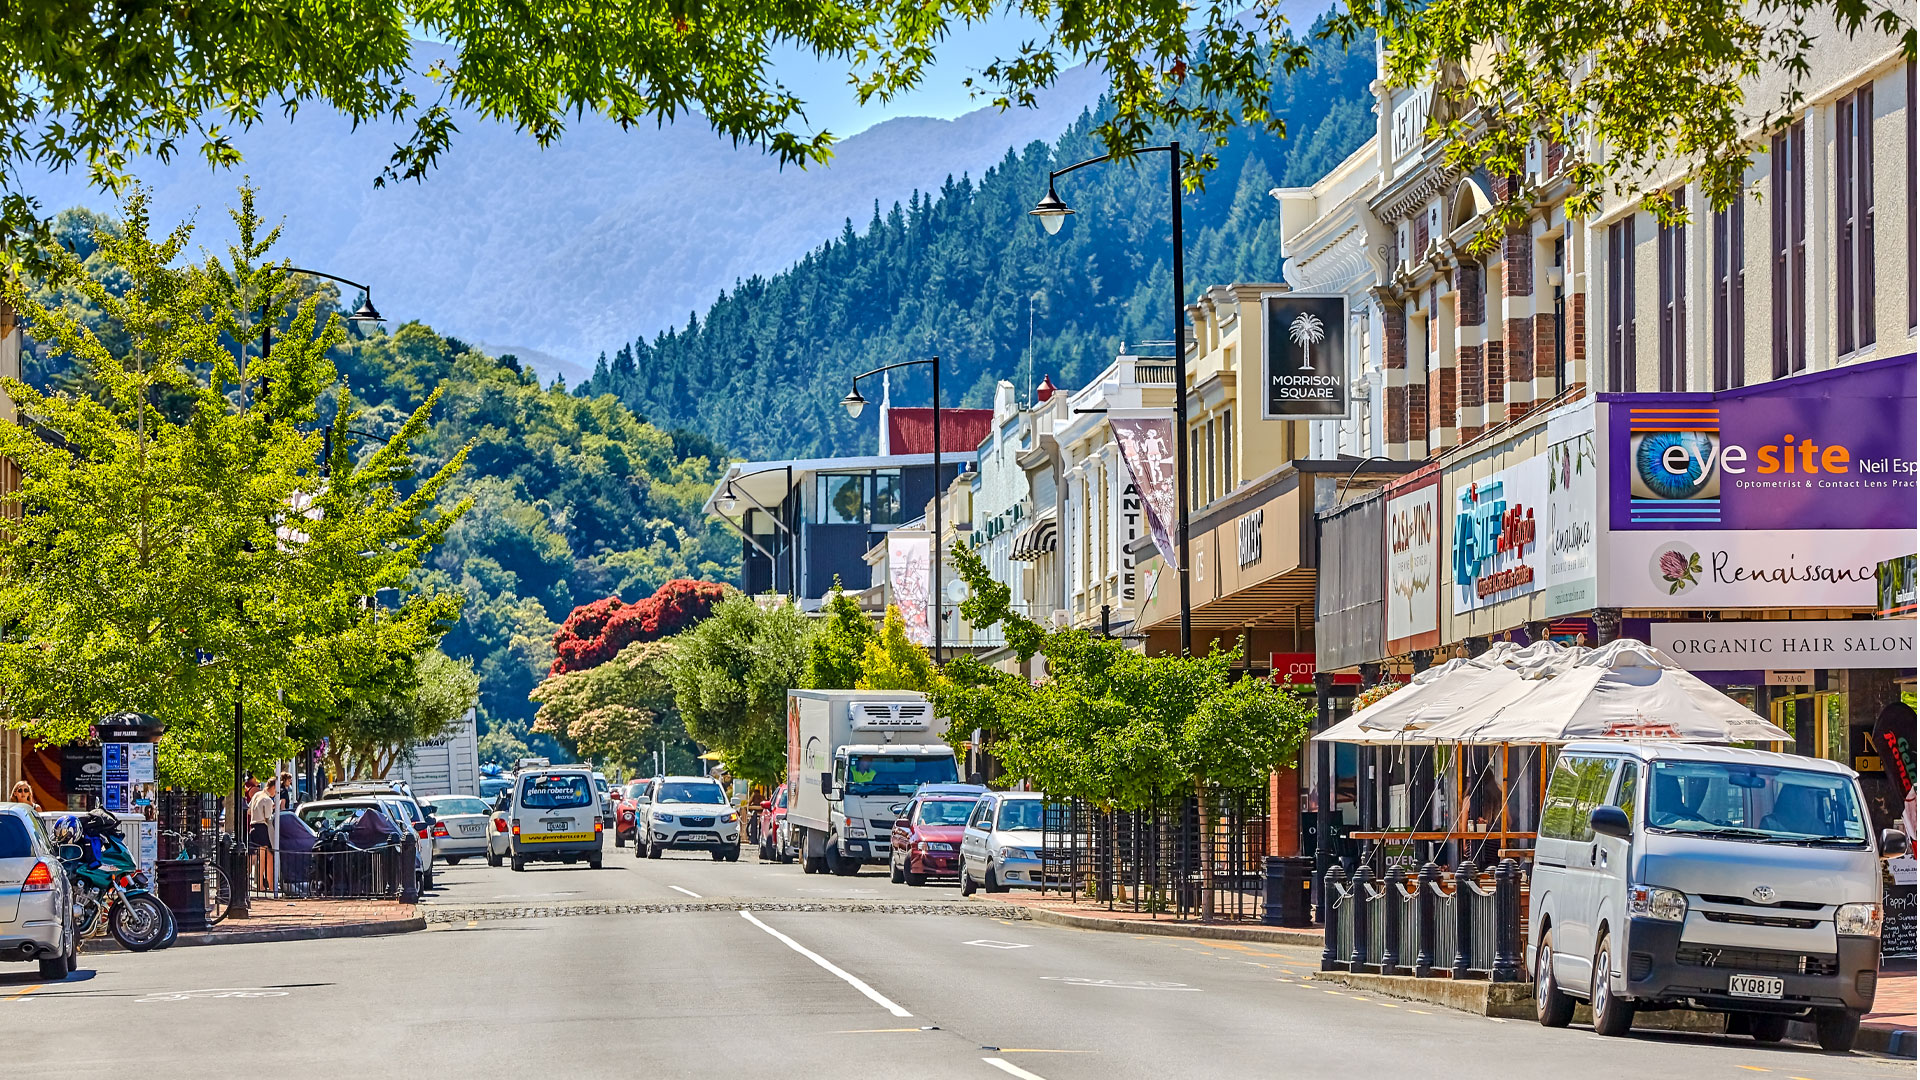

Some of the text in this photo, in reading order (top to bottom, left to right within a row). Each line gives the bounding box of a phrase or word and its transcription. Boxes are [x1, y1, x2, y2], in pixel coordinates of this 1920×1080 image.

[1272, 375, 1340, 386] MORRISON
[1280, 387, 1334, 399] SQUARE
[1662, 434, 1850, 486] eye site
[1859, 458, 1889, 473] Neil
[1736, 480, 1801, 489] Optometrist
[1805, 480, 1812, 488] &
[1818, 480, 1860, 488] Contact
[1864, 480, 1888, 488] Lens
[1413, 500, 1432, 548] VINO
[1672, 636, 1913, 654] ORGANIC HAIR SALON
[1614, 729, 1669, 738] STELLA
[527, 786, 574, 797] glenn roberts
[1731, 977, 1783, 994] KYQ819
